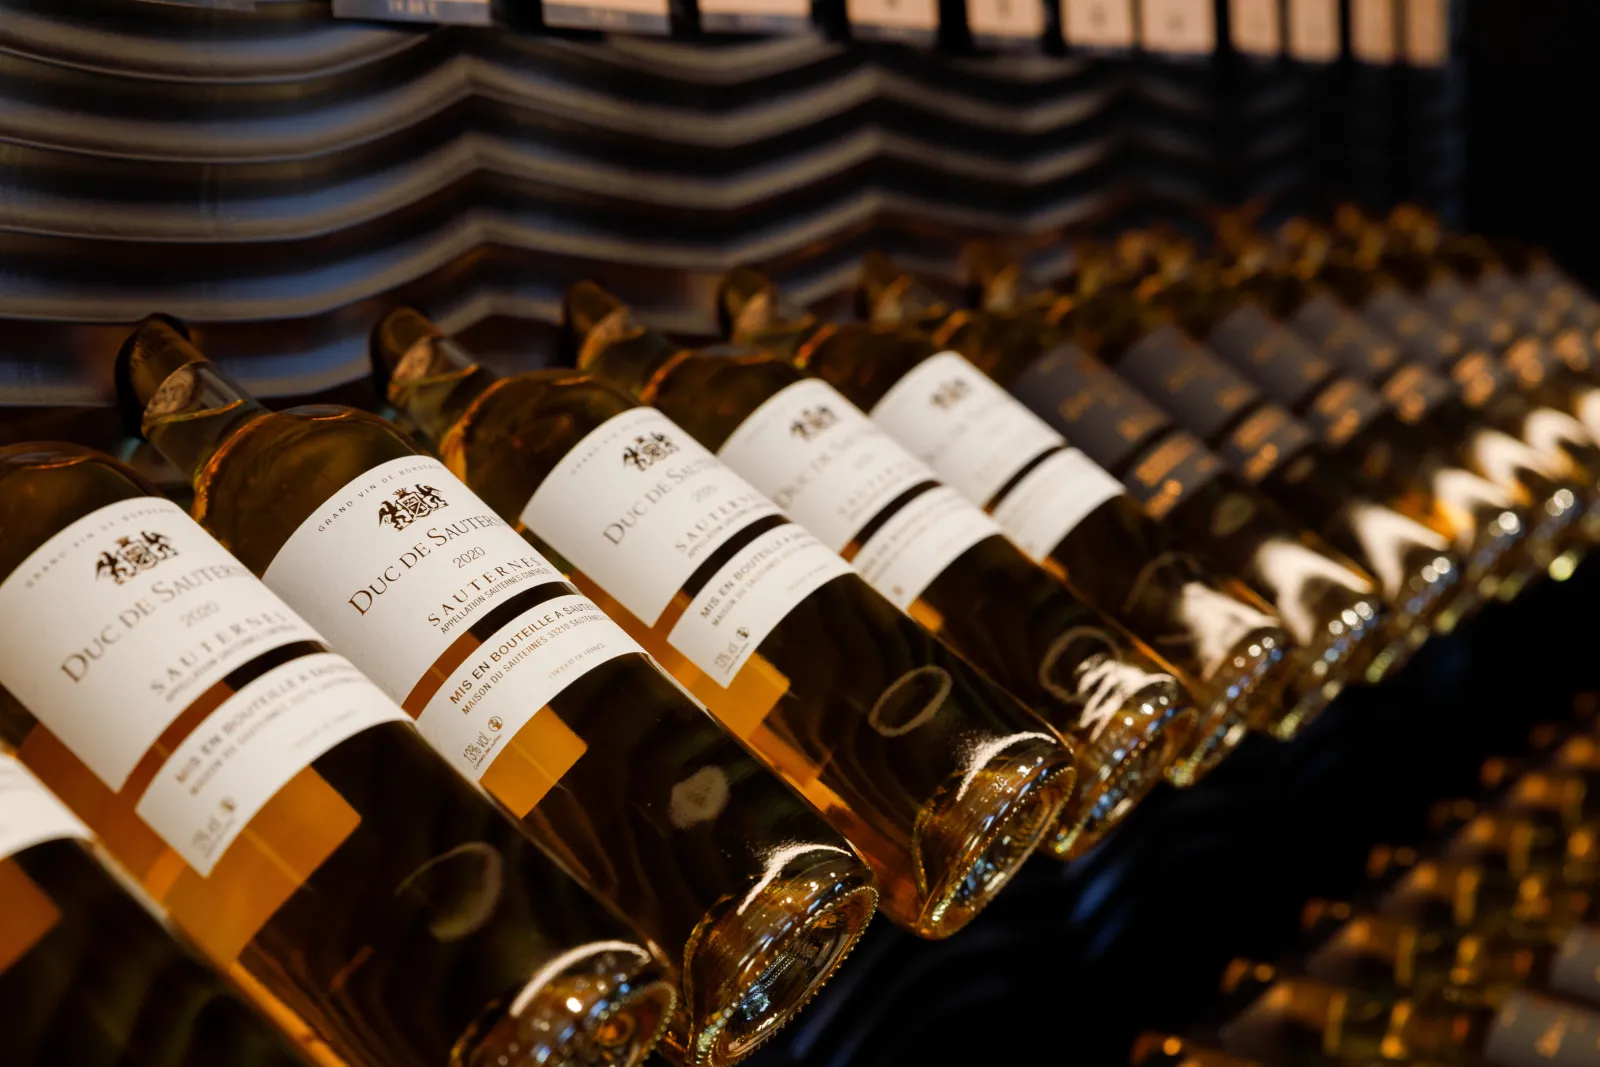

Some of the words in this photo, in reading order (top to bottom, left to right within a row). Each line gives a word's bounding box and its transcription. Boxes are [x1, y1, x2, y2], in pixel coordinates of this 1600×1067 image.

[318, 500, 353, 533] GRAND
[357, 484, 377, 498] VIN
[381, 474, 395, 484] DE
[603, 501, 649, 545] DUC
[645, 478, 673, 504] DE
[348, 565, 402, 616] DUC
[399, 542, 431, 570] DE
[452, 546, 486, 569] 2020
[428, 556, 542, 627] SAUTERNES
[440, 595, 486, 635] APPELLATION
[485, 575, 522, 598] SAUTERNES
[701, 596, 720, 618] MIS
[718, 580, 734, 597] EN
[60, 624, 122, 684] DUC
[118, 598, 157, 629] DE
[450, 680, 473, 704] MIS
[472, 661, 491, 680] EN
[490, 614, 554, 663] BOUTEILLE
[554, 610, 564, 619] A
[462, 682, 492, 715] MAISON
[491, 671, 504, 684] DU
[503, 636, 548, 672] SAUTERNES
[547, 623, 571, 639] 33210
[463, 743, 482, 763] 13%
